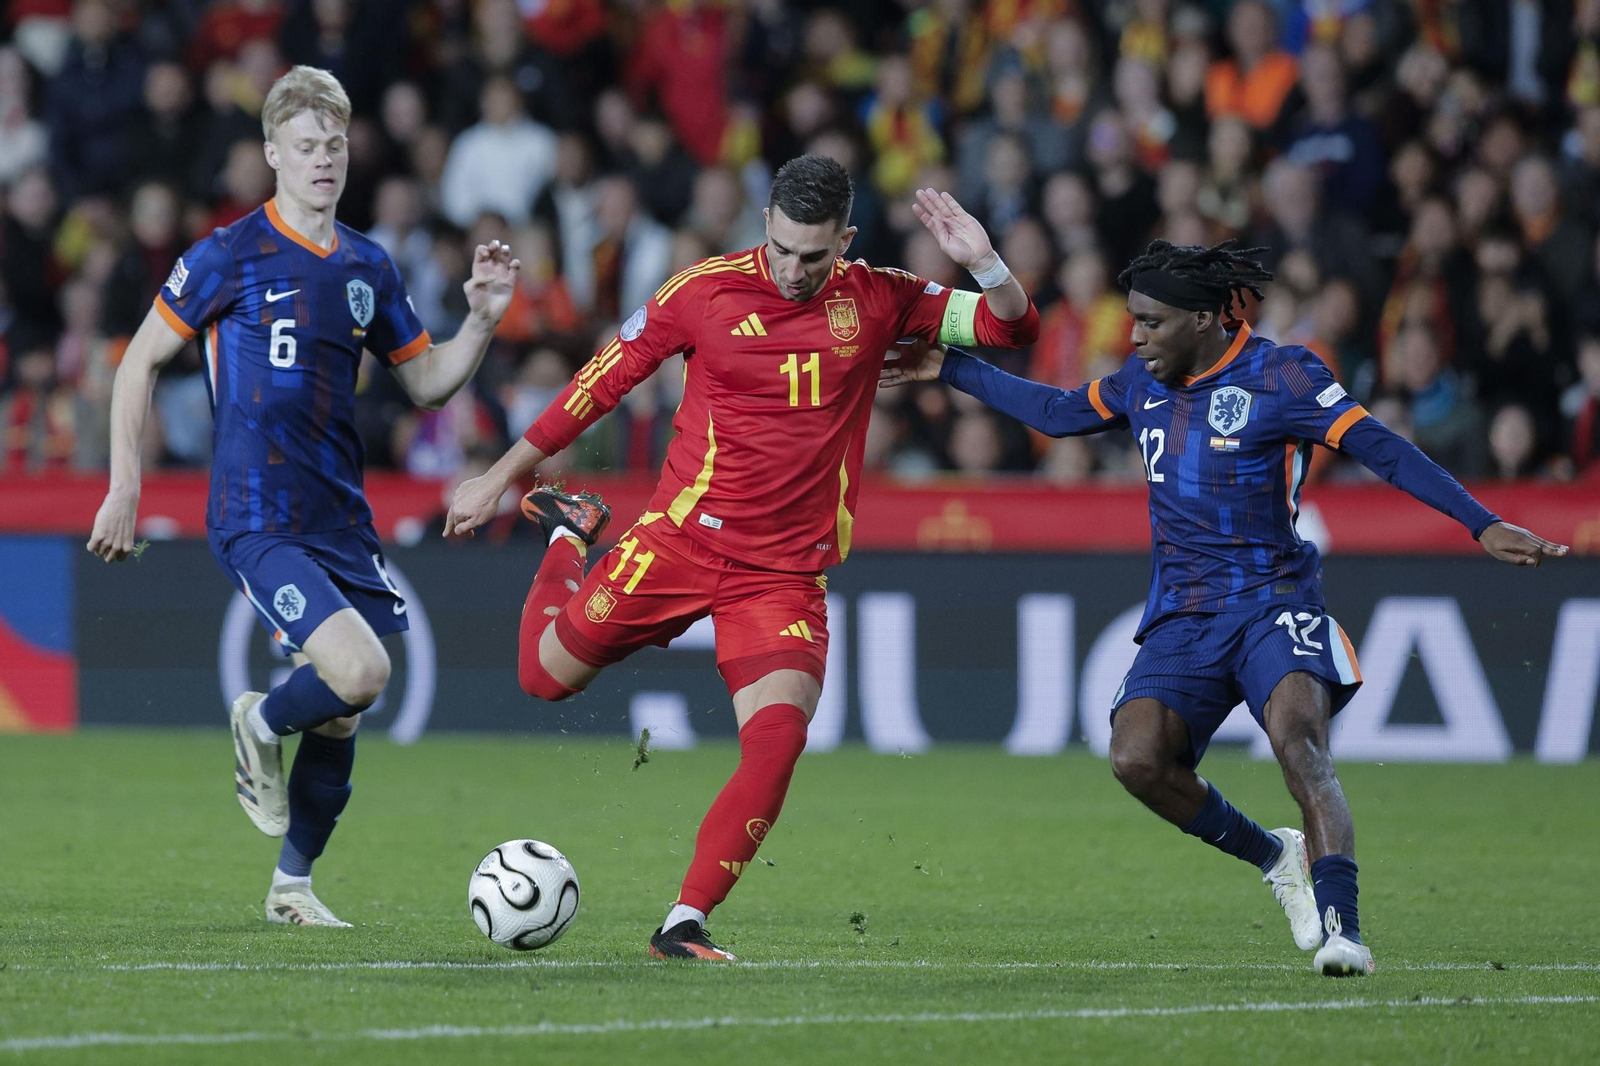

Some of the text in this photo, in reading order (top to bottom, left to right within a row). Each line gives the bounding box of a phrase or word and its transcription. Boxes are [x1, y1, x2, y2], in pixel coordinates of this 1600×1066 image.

[269, 318, 297, 368] 6
[779, 352, 821, 407] 11
[1139, 427, 1165, 482] 12
[607, 536, 656, 596] 11
[1274, 611, 1324, 651] 12
